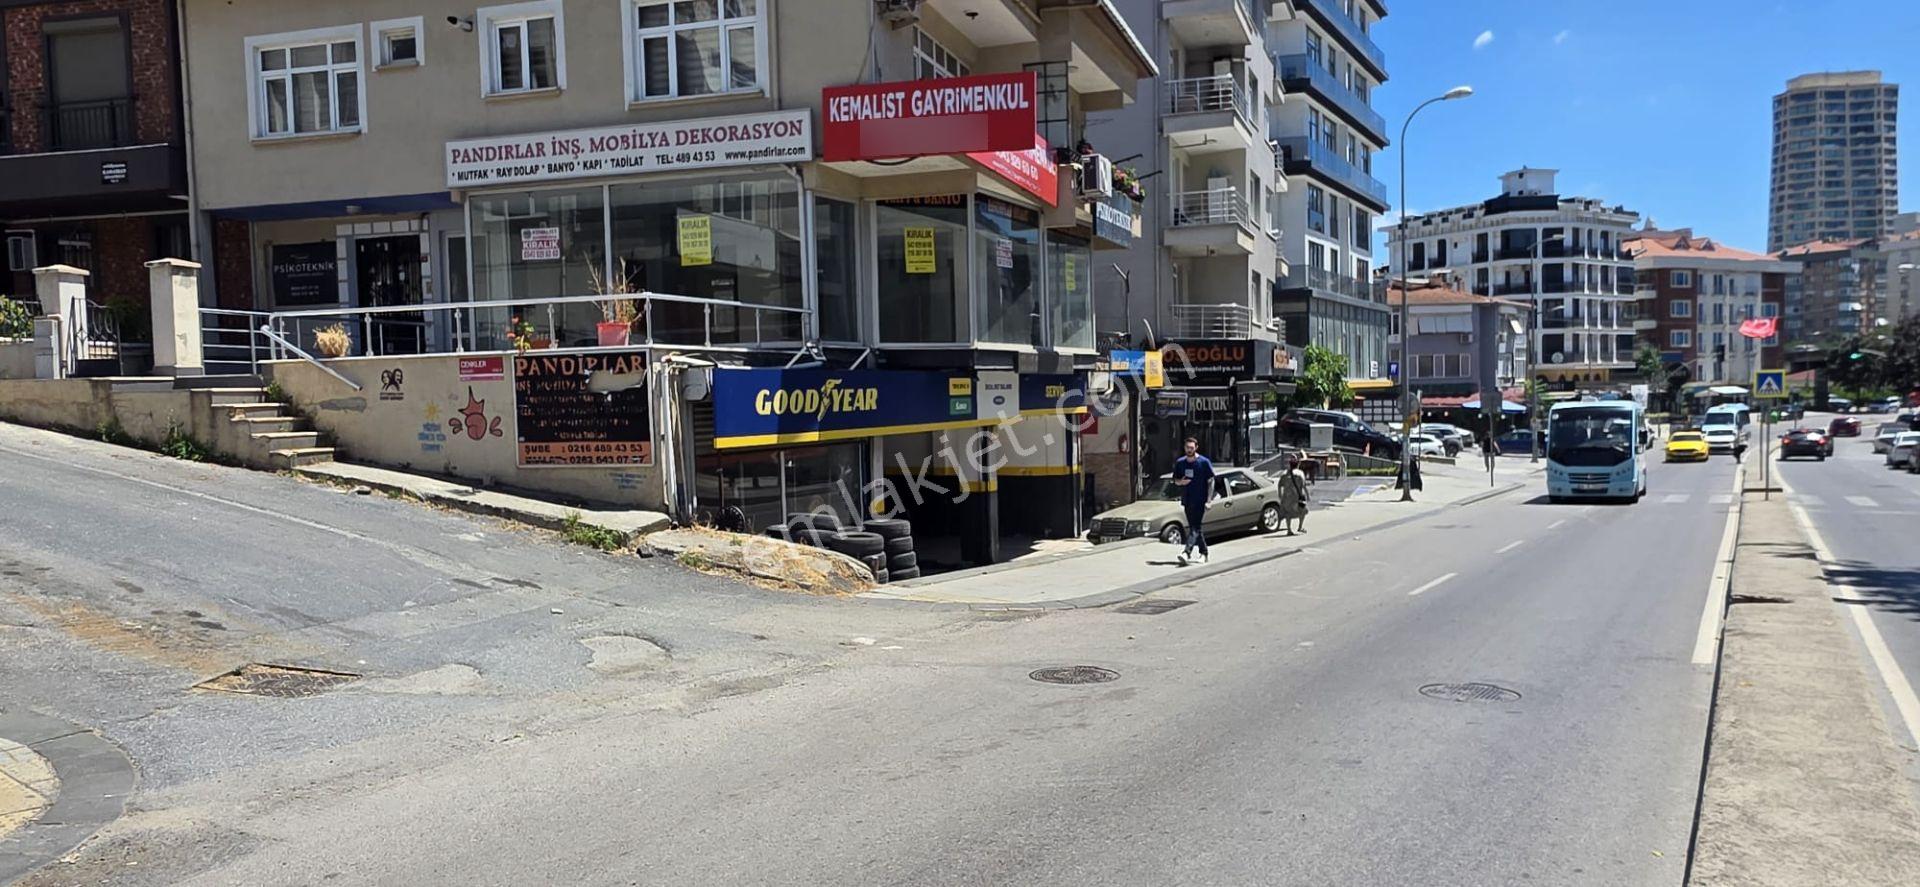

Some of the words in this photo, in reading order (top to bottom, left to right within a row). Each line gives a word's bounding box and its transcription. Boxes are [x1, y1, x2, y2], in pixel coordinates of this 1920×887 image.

[452, 142, 546, 164] PANDIRLAR
[551, 136, 585, 160] İNŞ.
[589, 129, 670, 154] MOBİLYA
[675, 120, 803, 146] DEKORASYON
[457, 169, 489, 182] MUTFAK
[514, 165, 540, 176] DOLAP
[548, 161, 575, 174] BANYO
[583, 159, 602, 171] KAPI
[611, 154, 644, 168] TADİLAT
[656, 154, 674, 165] TEL:
[676, 153, 690, 163] 489
[692, 151, 703, 162] 43
[705, 150, 715, 161] 53
[725, 146, 806, 160] www.pandirlar.com
[755, 388, 878, 416] GOODYEAR
[524, 444, 551, 455] ŞUBE
[567, 444, 592, 453] 0216
[614, 444, 627, 453] 43
[630, 444, 643, 453] 53
